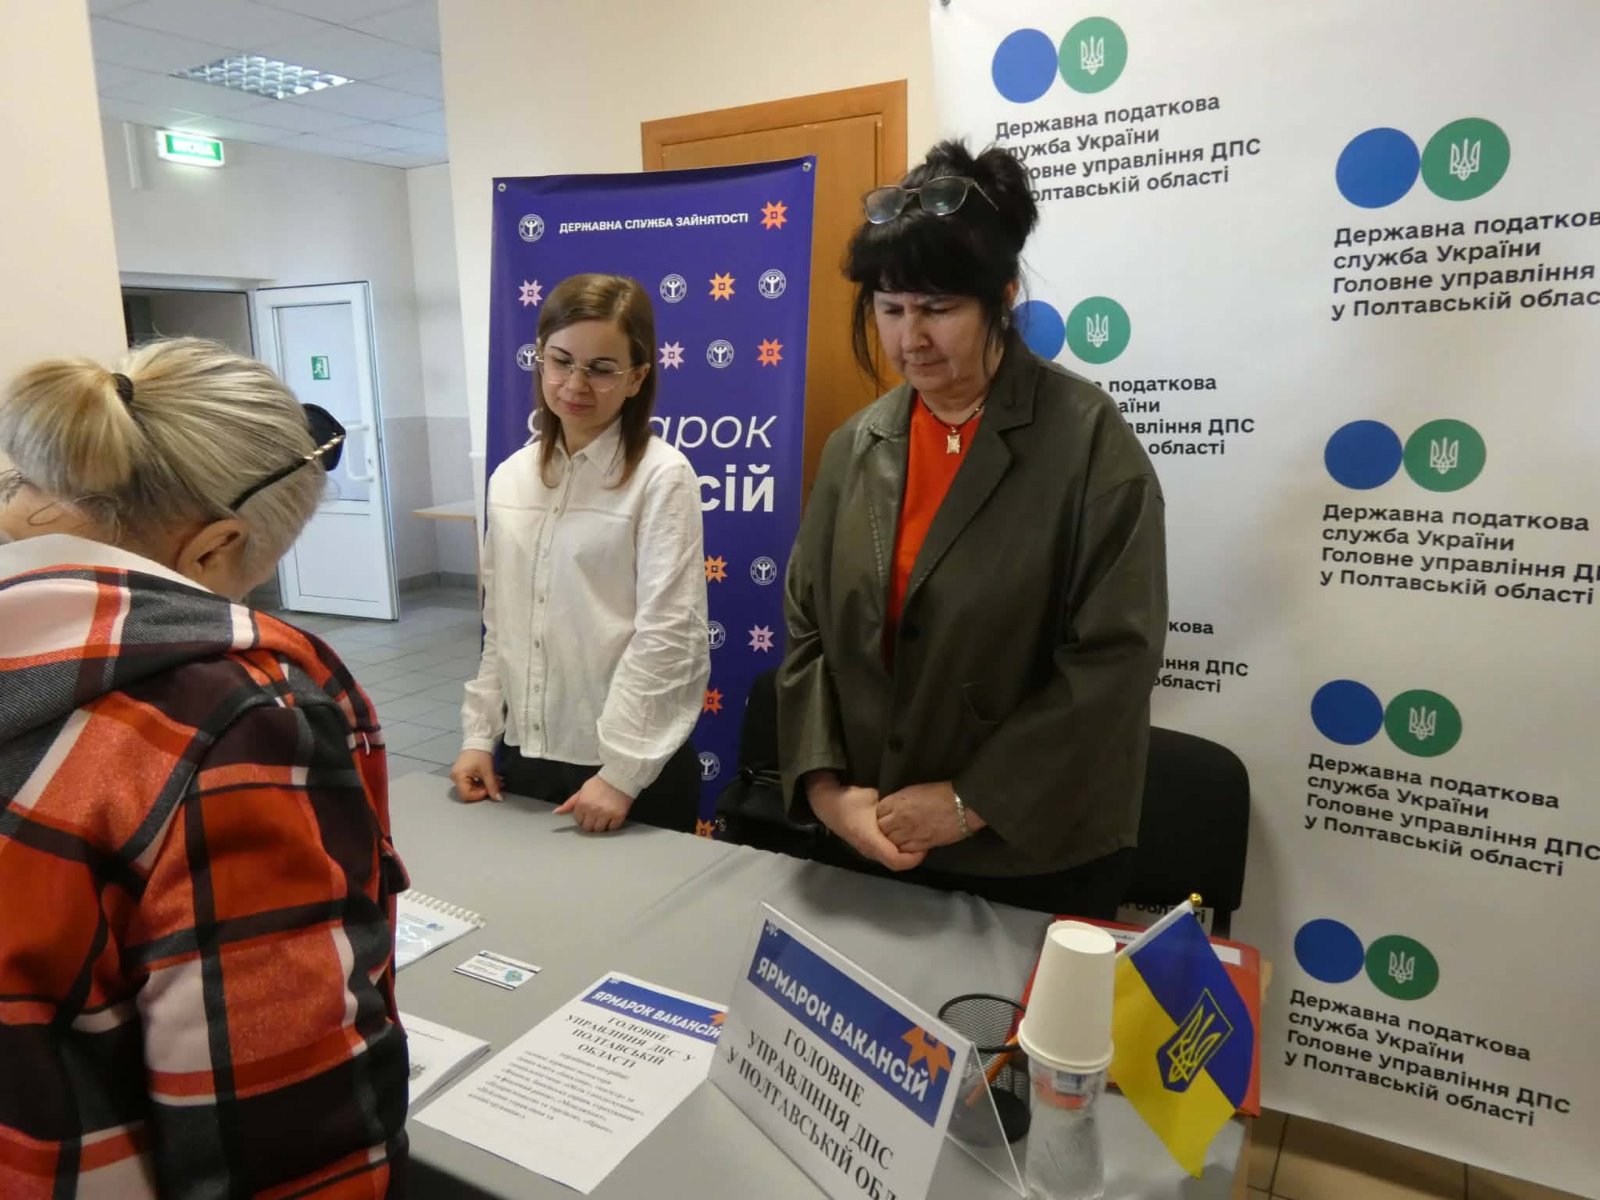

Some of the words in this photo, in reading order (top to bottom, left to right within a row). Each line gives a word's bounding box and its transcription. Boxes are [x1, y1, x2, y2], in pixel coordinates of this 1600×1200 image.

[996, 112, 1098, 141] Державна
[1104, 96, 1220, 124] податкова
[1007, 137, 1071, 162] лужба
[1077, 127, 1160, 152] України
[1028, 163, 1077, 180] овне
[1082, 148, 1204, 177] управління
[1211, 138, 1261, 162] ДПС
[1031, 176, 1140, 202] олтавській
[1146, 166, 1229, 190] області
[559, 221, 622, 234] ДЕРЖАВНА
[624, 217, 673, 229] СЛУЖБА
[675, 213, 749, 227] ЗАЙНЯТОСТІ
[1334, 220, 1465, 247] Державна
[1474, 210, 1600, 234] податков
[1333, 246, 1428, 271] служба
[1437, 240, 1541, 264] України
[1333, 274, 1433, 293] Головне
[1441, 263, 1595, 291] управління
[1331, 304, 1345, 322] у
[1354, 291, 1512, 316] Полтавській
[1520, 289, 1600, 308] облас
[1109, 377, 1217, 395] податкова
[1118, 398, 1160, 413] аїни
[1128, 419, 1201, 434] вління
[1208, 418, 1255, 436] ДПС
[1148, 440, 1225, 455] області
[1323, 504, 1444, 524] Державна
[1452, 510, 1589, 532] податкова
[1322, 527, 1409, 545] служба
[1417, 529, 1515, 552] України
[1322, 547, 1414, 567] Головне
[1420, 556, 1566, 579] управління
[1320, 570, 1334, 587] у
[1340, 570, 1487, 596] Полтавській
[1494, 583, 1594, 605] області
[1206, 660, 1248, 677] ДПС
[1307, 775, 1390, 801] служба
[1397, 788, 1489, 820] України
[1308, 753, 1422, 786] Державна
[1430, 775, 1560, 809] податкова
[1304, 814, 1317, 830] у
[1324, 816, 1463, 857] Полтавській
[1469, 848, 1564, 877] області
[1306, 793, 1394, 822] Головне
[1400, 812, 1537, 849] управління
[1544, 837, 1600, 861] ДПС
[591, 991, 655, 1017] ЯРМАРОК
[653, 1010, 724, 1039] ВАКАНСІЙ
[607, 1017, 670, 1042] ГОЛОВНЕ
[757, 957, 831, 1027] ЯРМАРОК
[831, 1012, 930, 1102] ВАКАНСІЙ
[1289, 989, 1401, 1028] Державна
[1407, 1019, 1531, 1062] податкова
[566, 1014, 647, 1047] УПРАВЛІННЯ
[648, 1043, 680, 1057] ДПС
[683, 1054, 696, 1063] У
[572, 1029, 665, 1066] ПОЛТАВСЬКІЙ
[577, 1043, 637, 1069] ОБЛАСТІ
[1288, 1012, 1368, 1042] служба
[1376, 1030, 1465, 1065] України
[783, 1028, 865, 1107] ГОЛОВНЕ
[1287, 1030, 1373, 1062] Головне
[1379, 1054, 1510, 1098] управління
[1516, 1087, 1571, 1114] ДПС
[748, 1030, 851, 1133] УПРАВЛІННЯ
[850, 1124, 894, 1170] ДПС
[1284, 1051, 1297, 1067] у
[1303, 1054, 1440, 1101] Полтавській
[1446, 1092, 1535, 1126] області
[727, 1046, 737, 1064] У
[738, 1060, 854, 1175] ПОЛТАВСЬКІЙ
